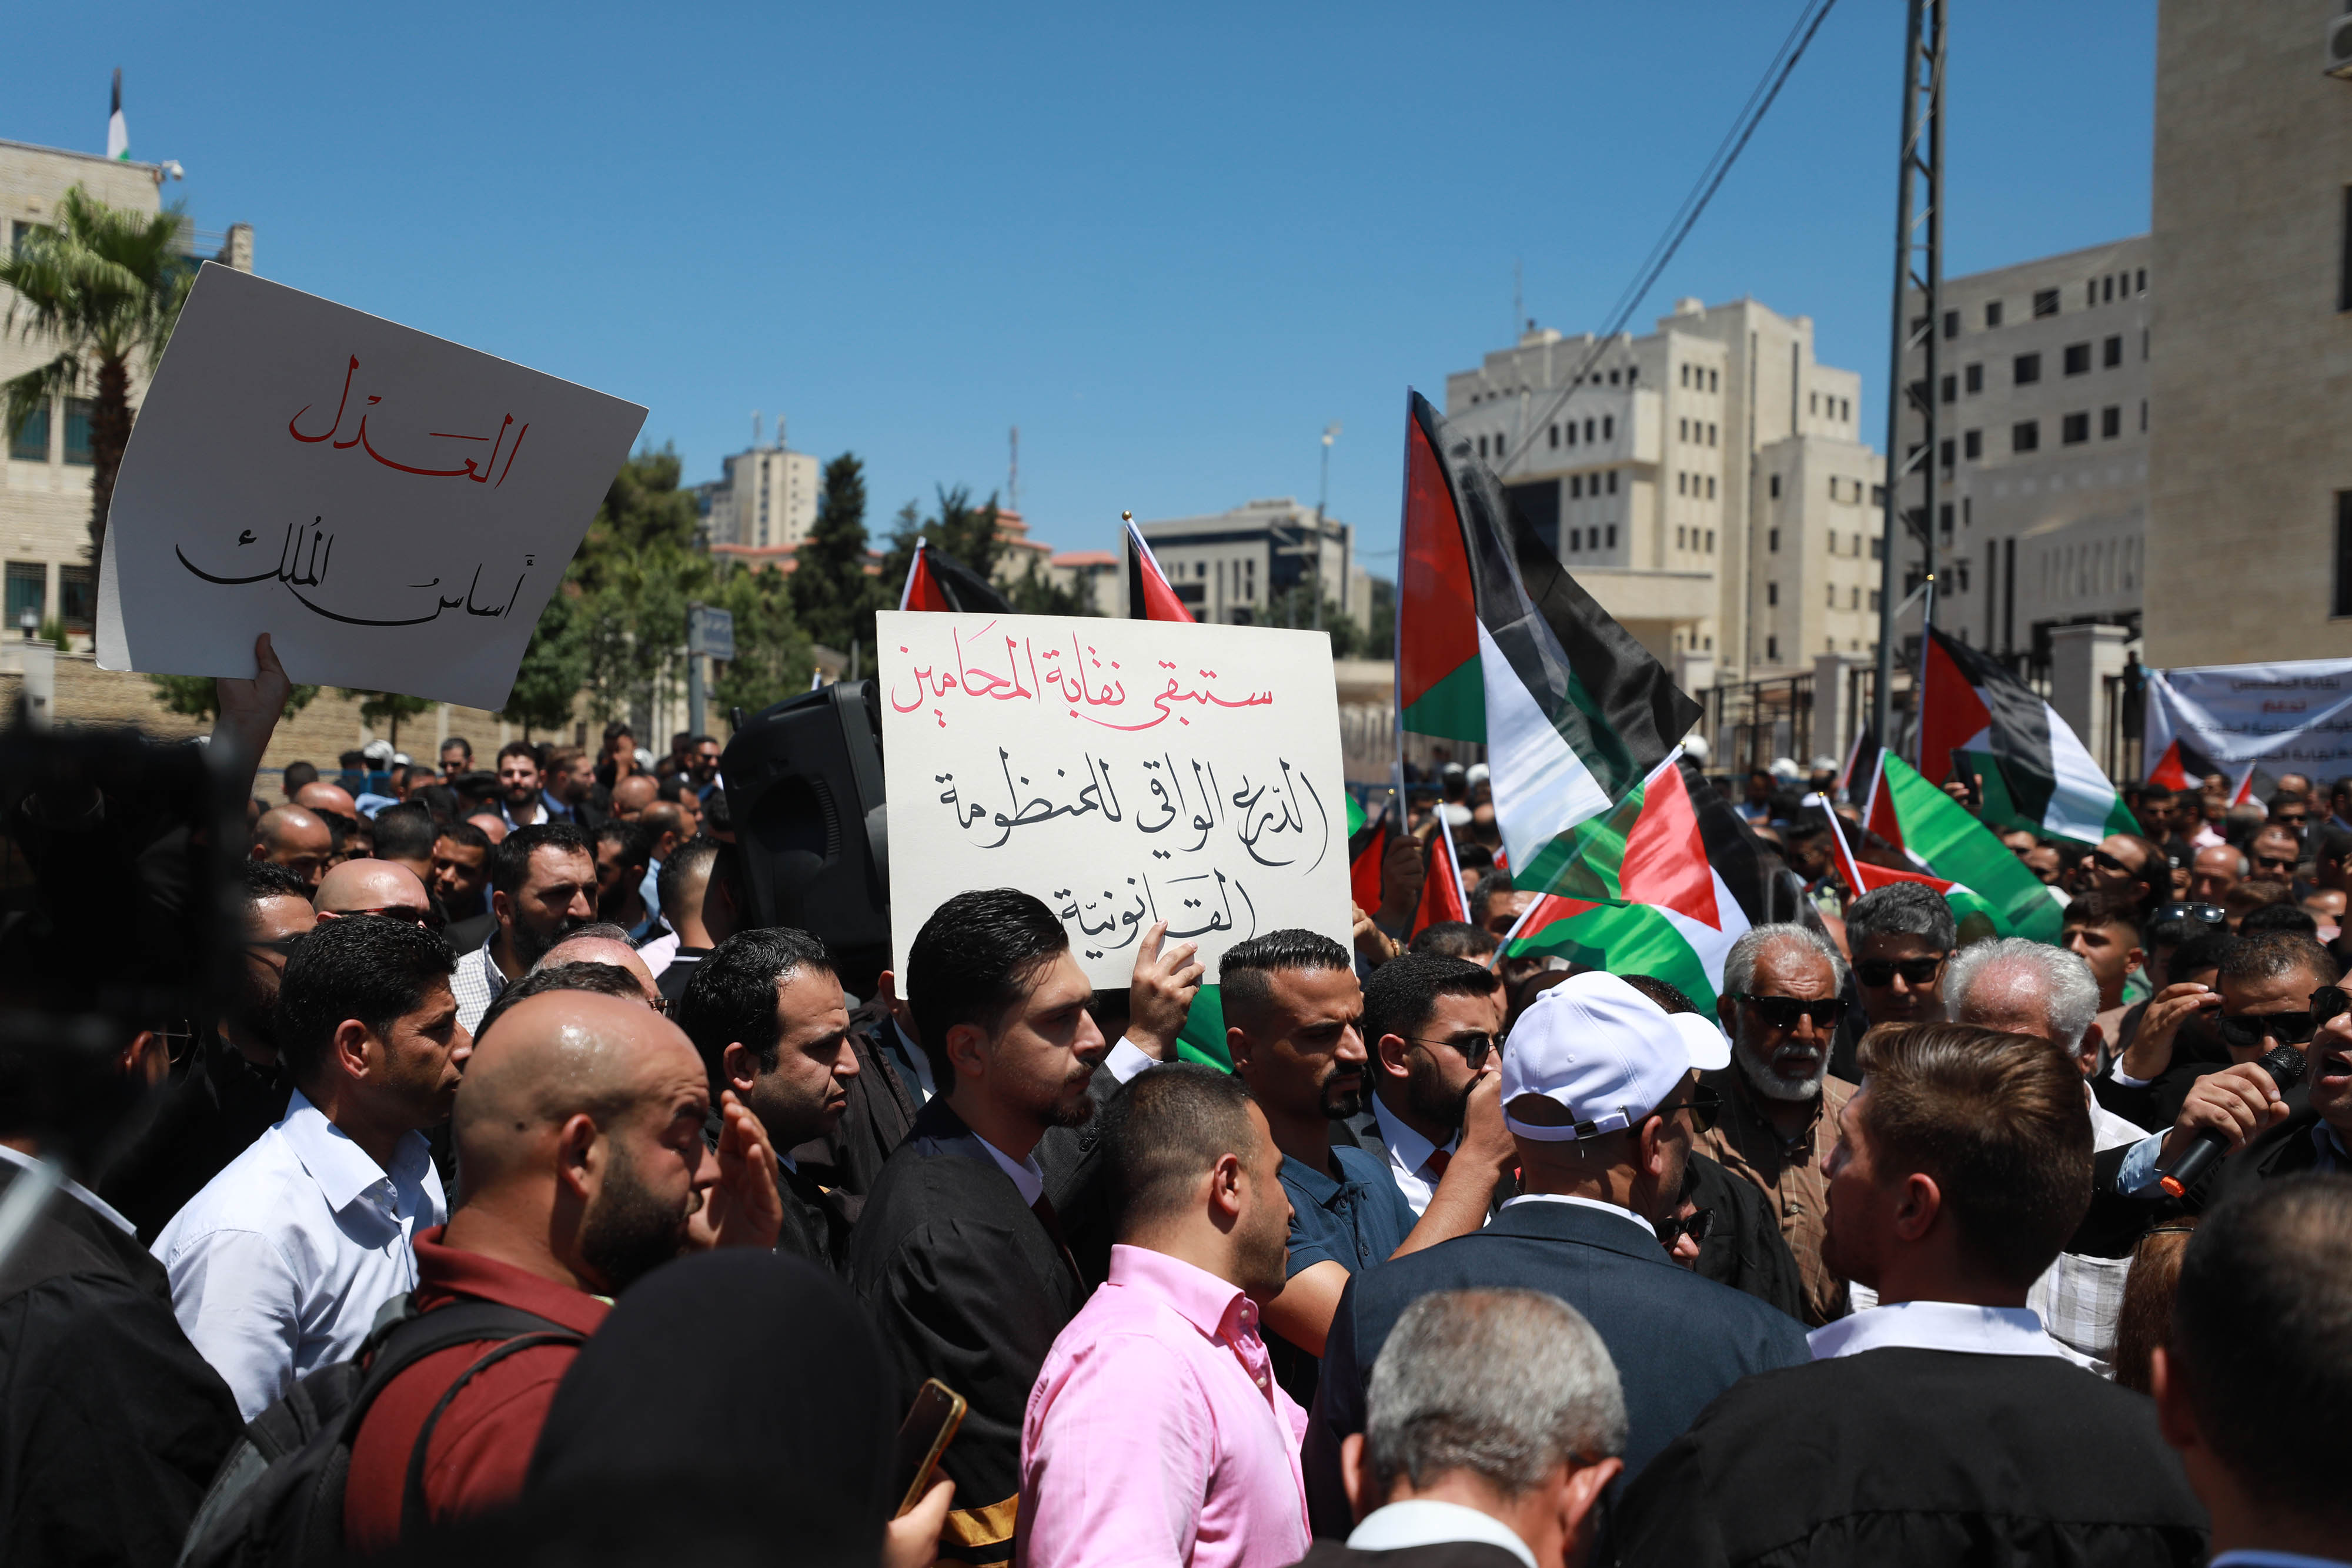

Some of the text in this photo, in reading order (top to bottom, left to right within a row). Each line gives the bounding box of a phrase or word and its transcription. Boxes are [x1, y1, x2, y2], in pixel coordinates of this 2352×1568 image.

[1042, 631, 1126, 718] نقابة
[935, 746, 1122, 849] للمنظومة
[1136, 752, 1225, 860] الواقي
